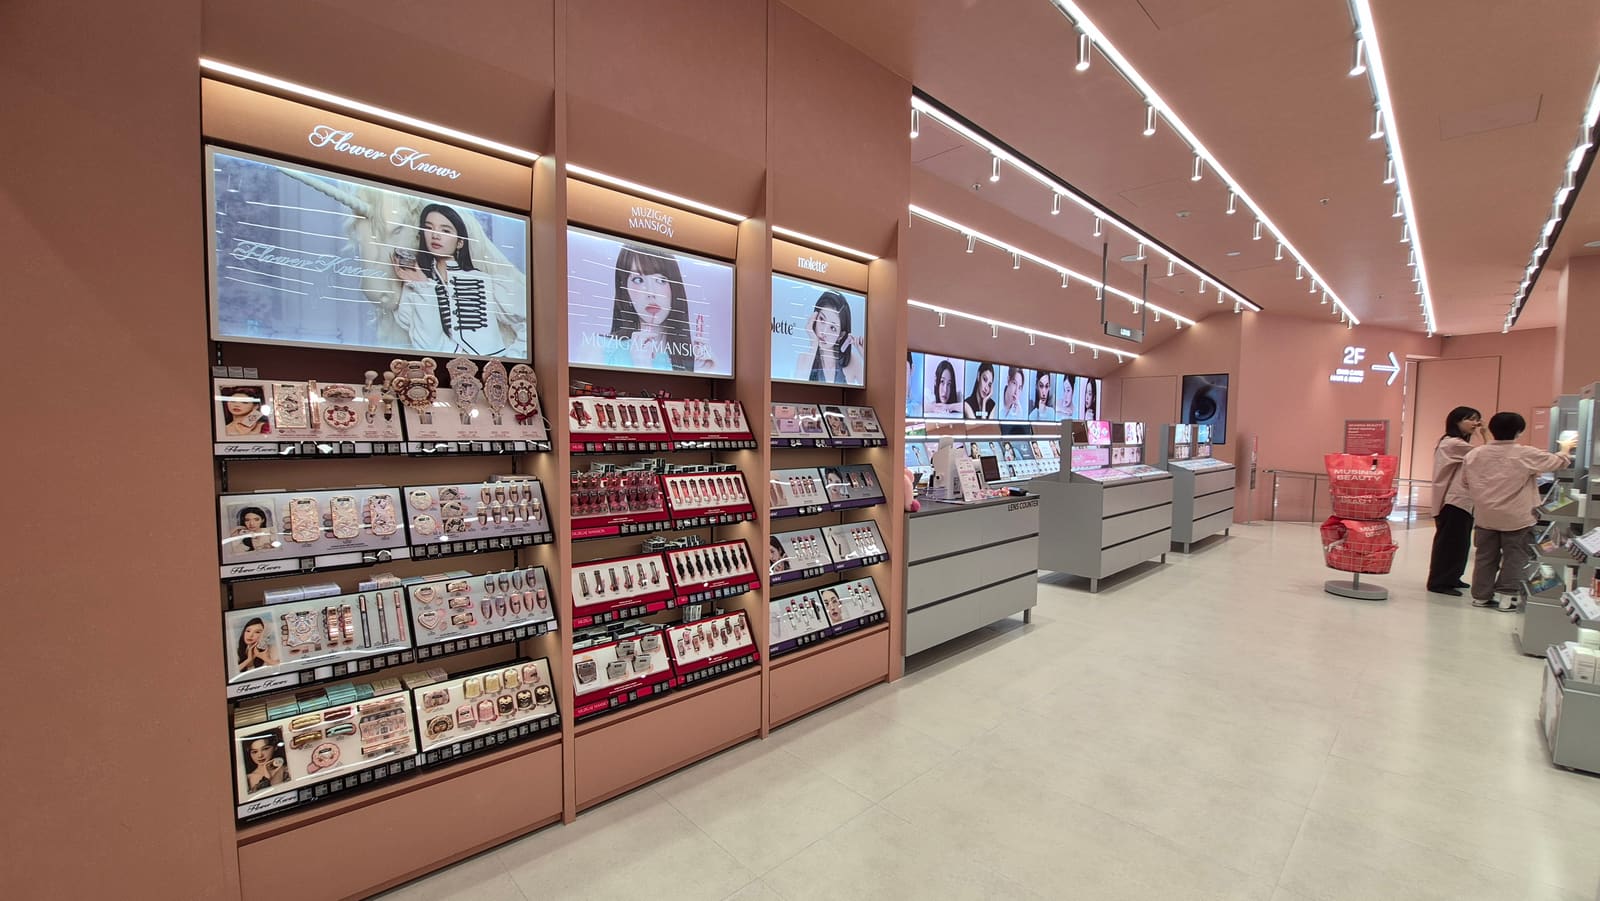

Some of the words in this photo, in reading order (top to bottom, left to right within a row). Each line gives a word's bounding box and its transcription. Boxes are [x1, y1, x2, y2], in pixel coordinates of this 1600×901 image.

[308, 125, 387, 160] Flower
[389, 146, 462, 180] Knows
[631, 206, 673, 227] MUZIGAE
[628, 217, 674, 238] MANSION
[232, 240, 313, 267] Flower
[771, 316, 795, 336] lette
[581, 331, 648, 353] MUZIGAE
[650, 339, 712, 359] MANSION
[1343, 346, 1366, 365] 2F
